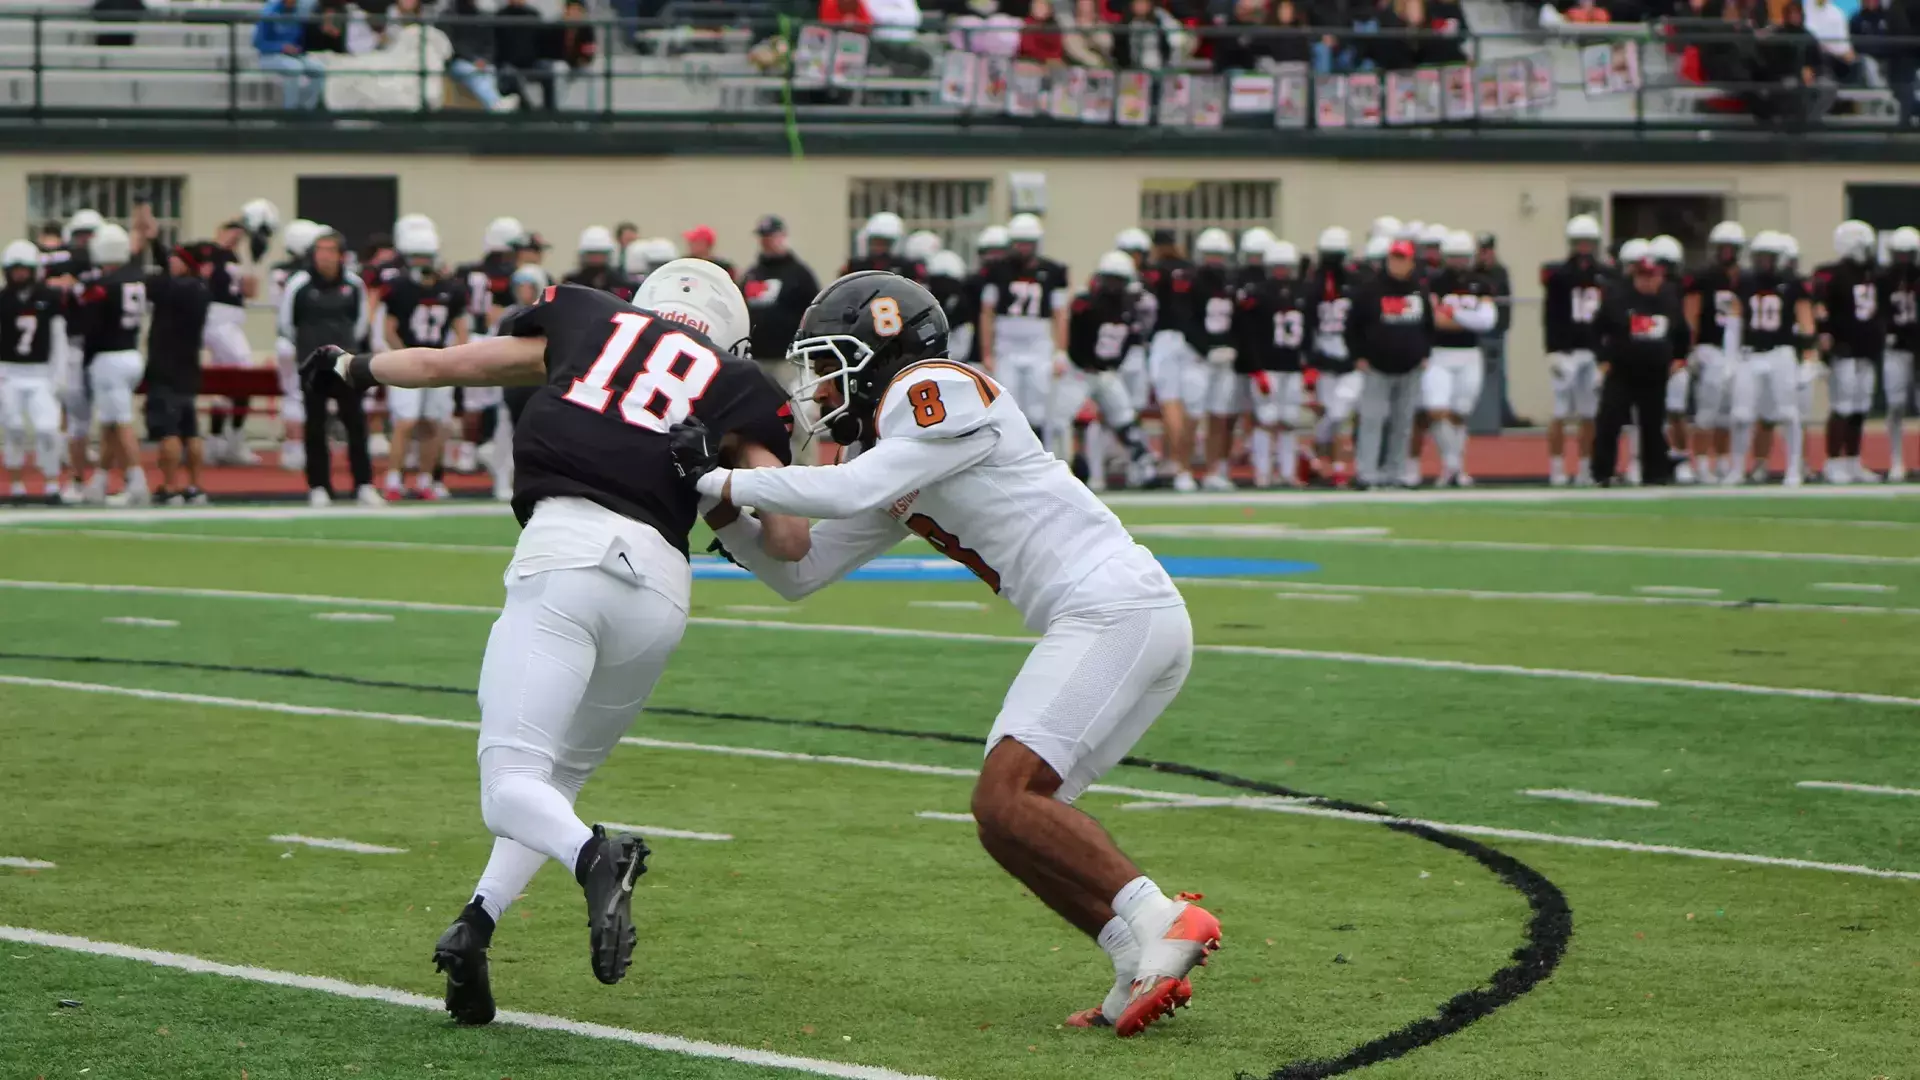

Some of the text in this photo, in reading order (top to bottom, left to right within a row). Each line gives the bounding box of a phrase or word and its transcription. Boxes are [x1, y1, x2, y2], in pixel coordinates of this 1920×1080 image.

[15, 314, 39, 356] 7
[409, 303, 449, 345] 47
[870, 297, 903, 336] 8
[1273, 309, 1305, 348] 13
[561, 311, 723, 435] 18
[907, 379, 948, 429] 8
